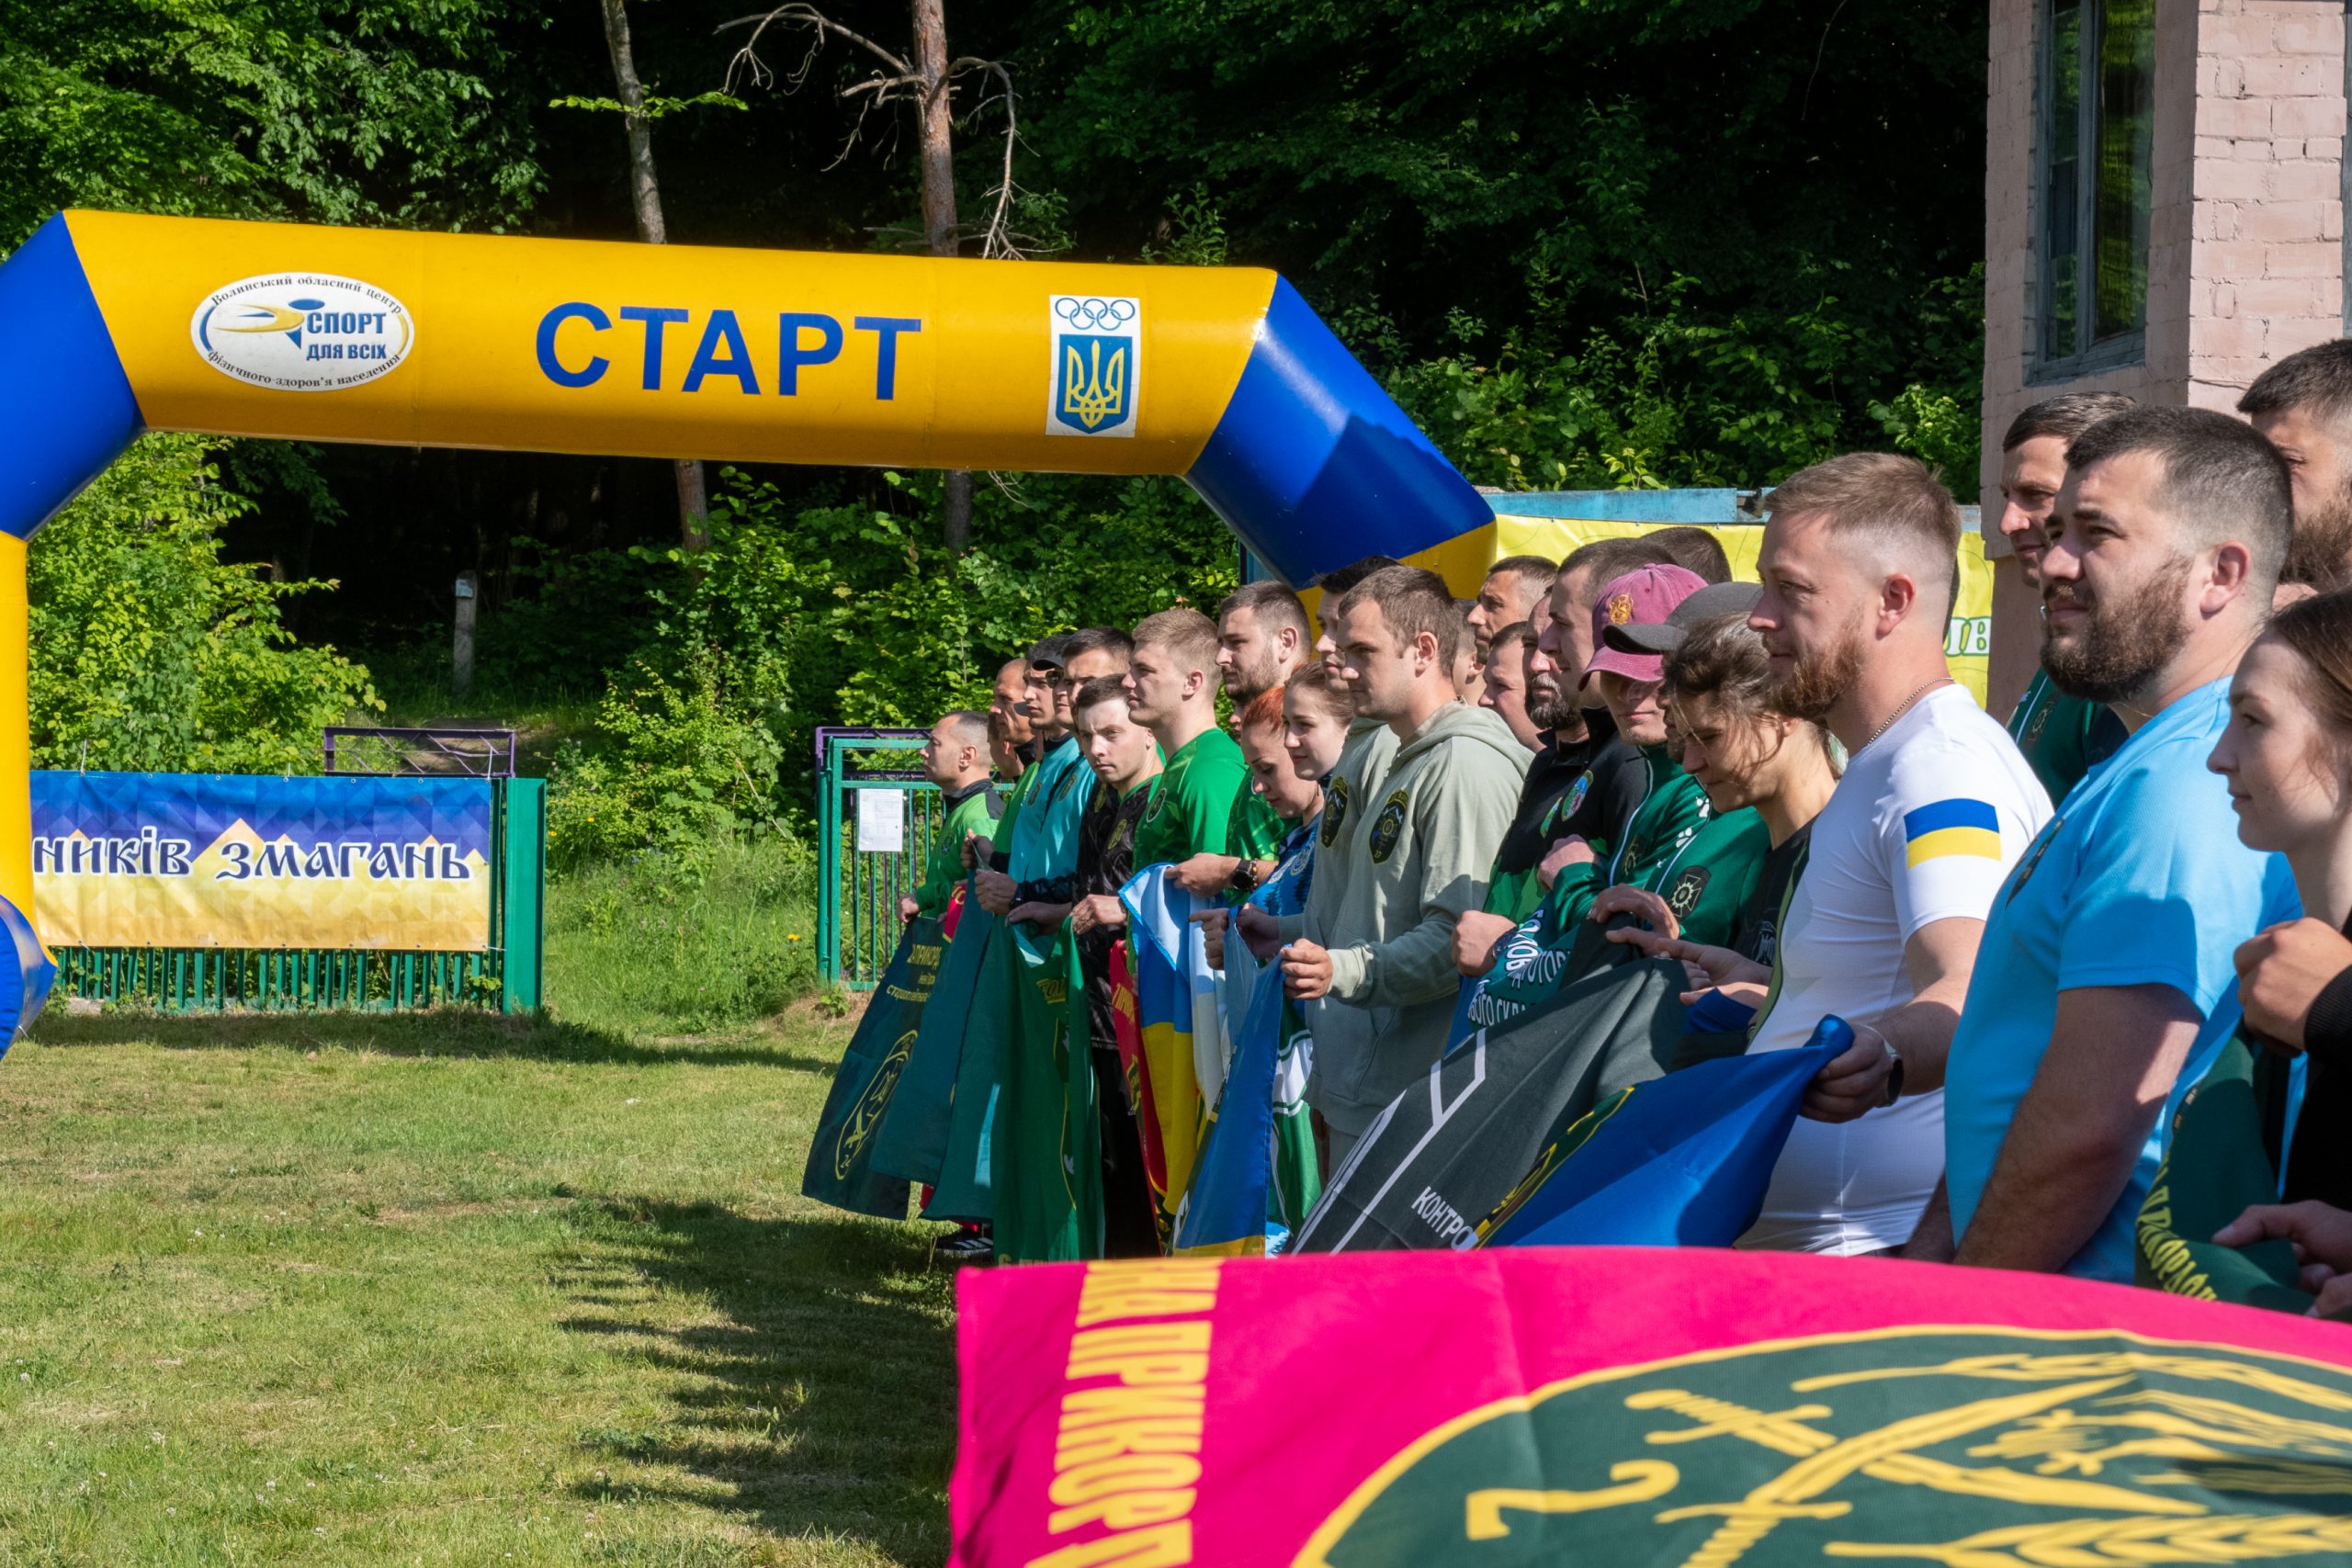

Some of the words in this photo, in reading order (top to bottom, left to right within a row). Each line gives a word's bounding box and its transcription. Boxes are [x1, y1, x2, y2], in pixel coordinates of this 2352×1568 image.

[211, 276, 292, 307] Волинський
[297, 276, 362, 293] обласний
[366, 288, 402, 314] центр
[306, 311, 387, 334] СПОРТ
[208, 350, 272, 384] фізичного
[336, 354, 401, 386] населення
[306, 343, 343, 361] ДЛЯ
[347, 344, 387, 360] ВСІХ
[536, 301, 922, 401] СТАРТ
